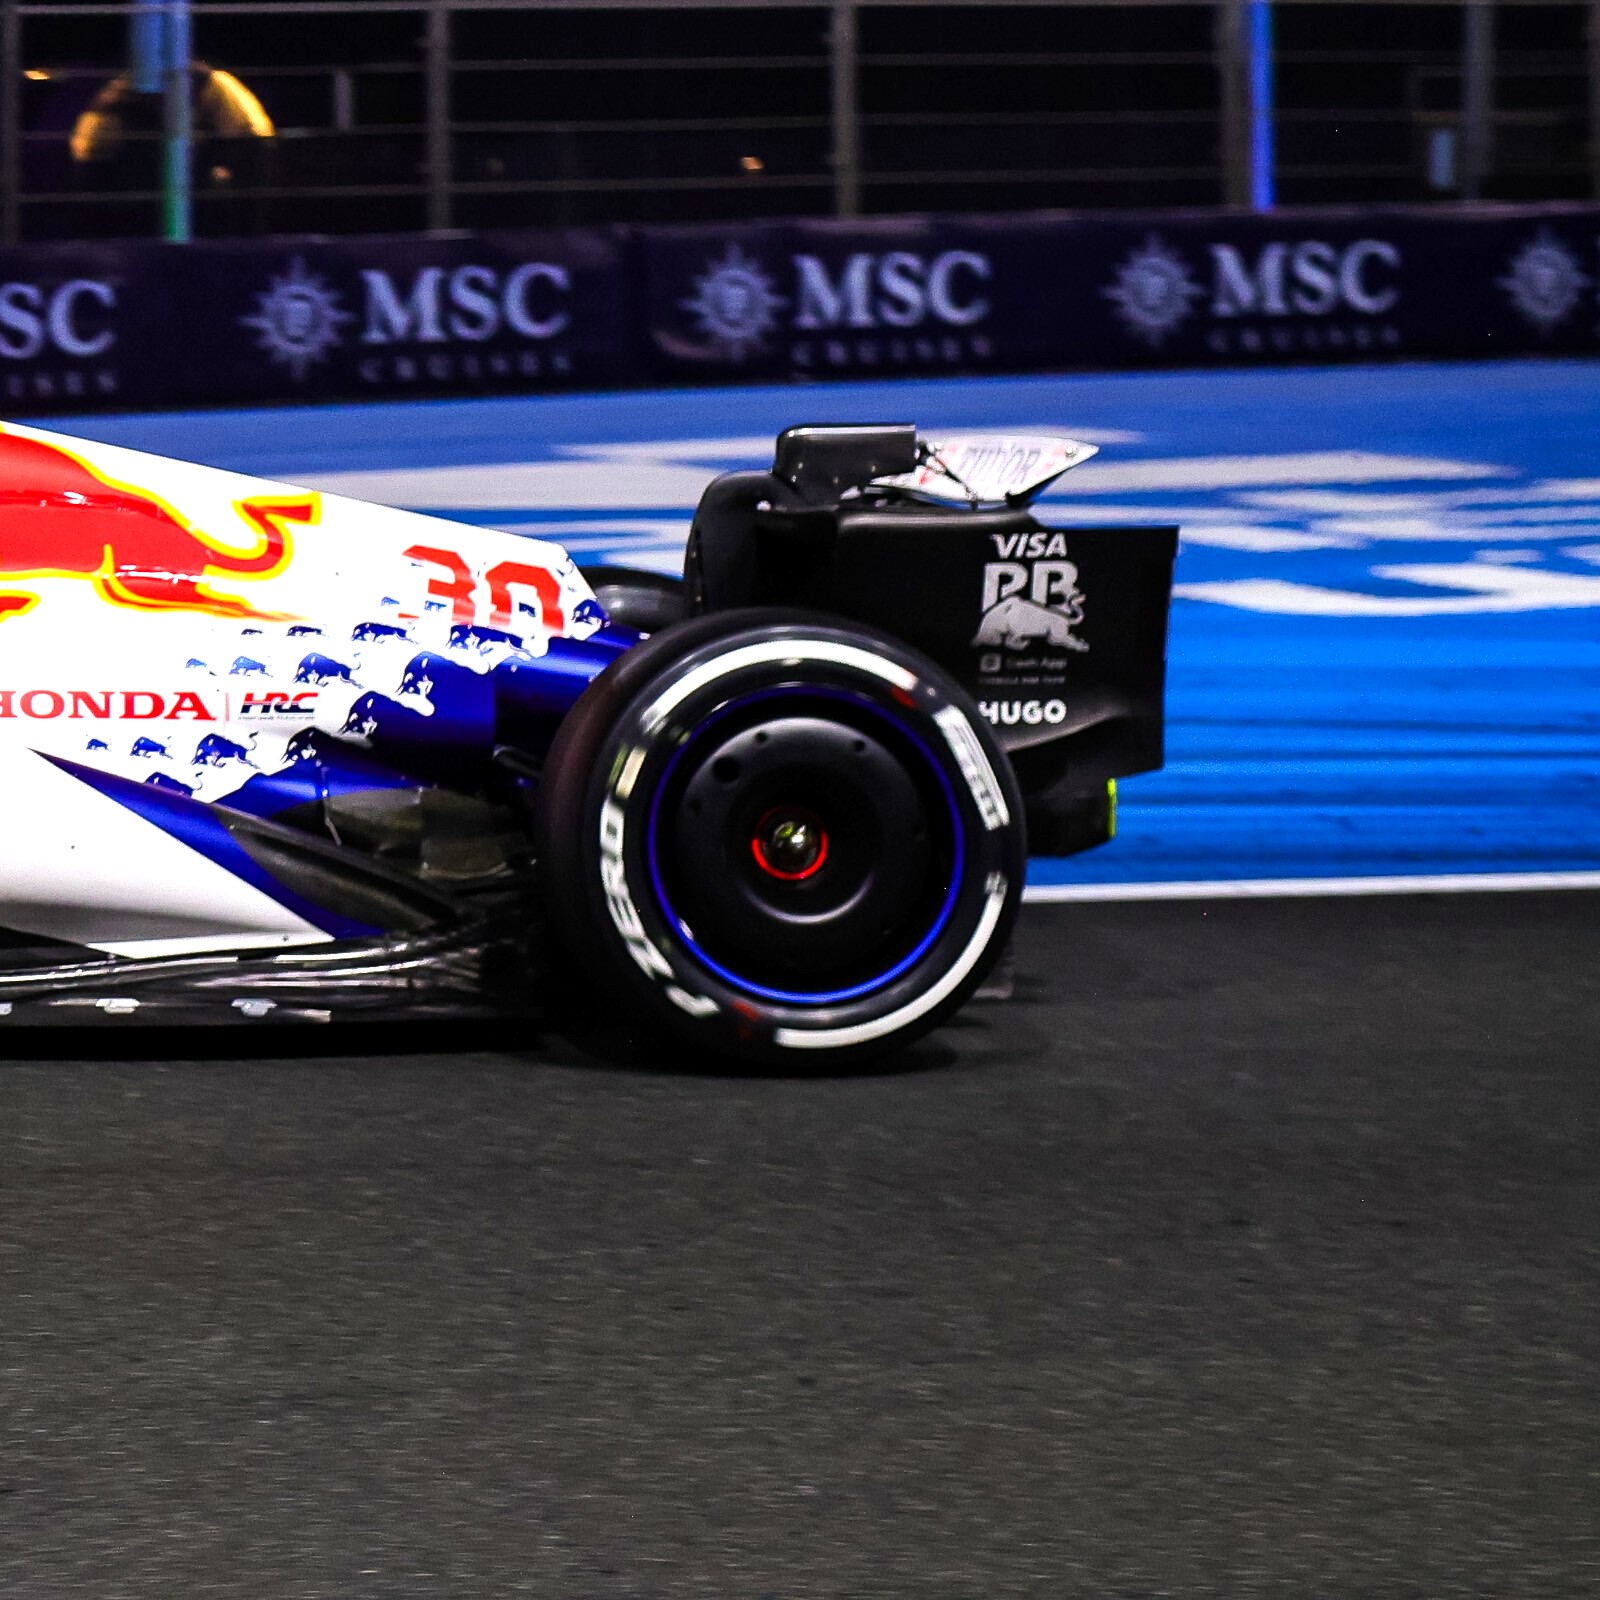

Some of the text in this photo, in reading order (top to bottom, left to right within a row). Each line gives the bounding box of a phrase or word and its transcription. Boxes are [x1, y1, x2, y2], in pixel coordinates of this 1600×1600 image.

[361, 263, 570, 343] MSC
[792, 250, 991, 329] MSC
[1210, 239, 1399, 318] MSC
[990, 533, 1068, 559] VISA
[240, 692, 319, 714] HRC
[978, 699, 1068, 725] HUGO
